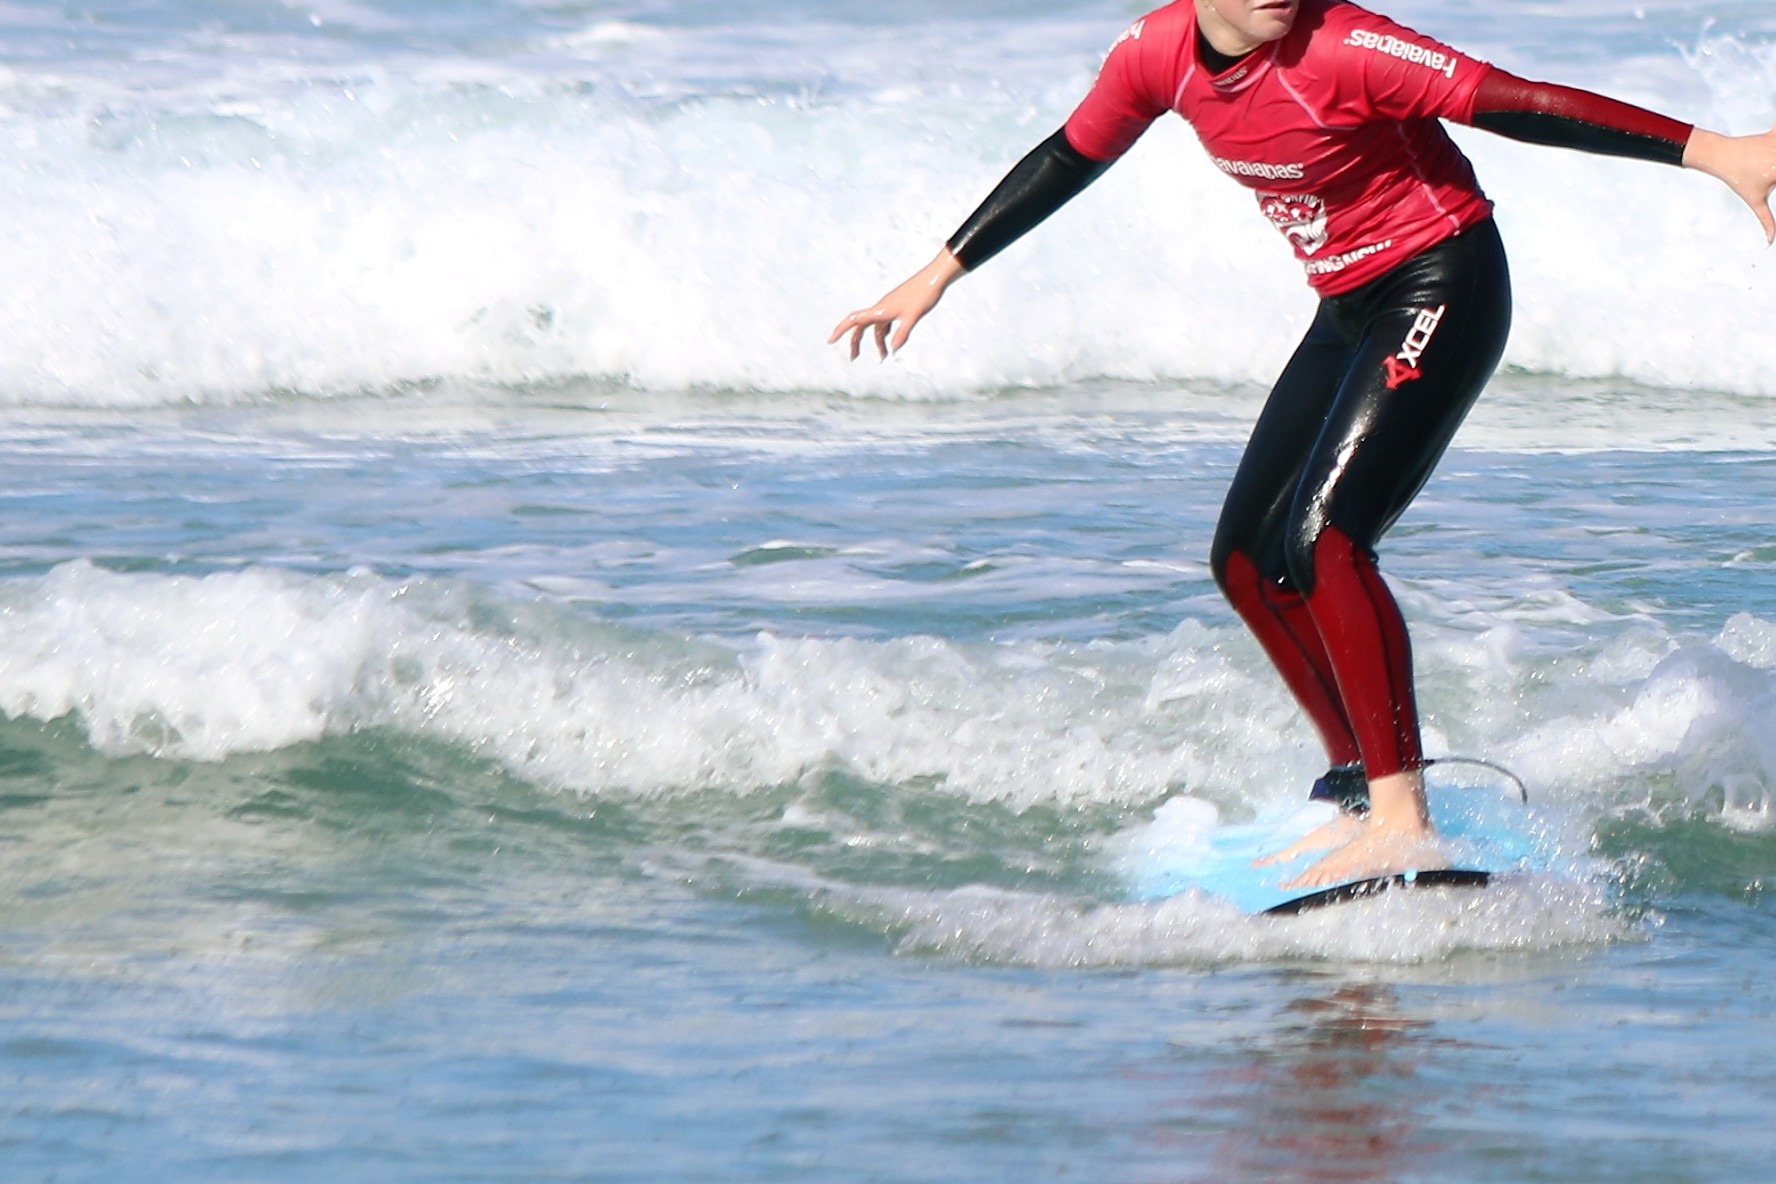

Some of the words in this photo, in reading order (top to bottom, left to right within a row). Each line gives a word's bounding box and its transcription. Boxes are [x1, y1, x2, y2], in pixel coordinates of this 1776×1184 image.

[1344, 29, 1457, 78] havaianas
[1211, 156, 1304, 180] avaianas
[1396, 304, 1446, 369] XCEL
